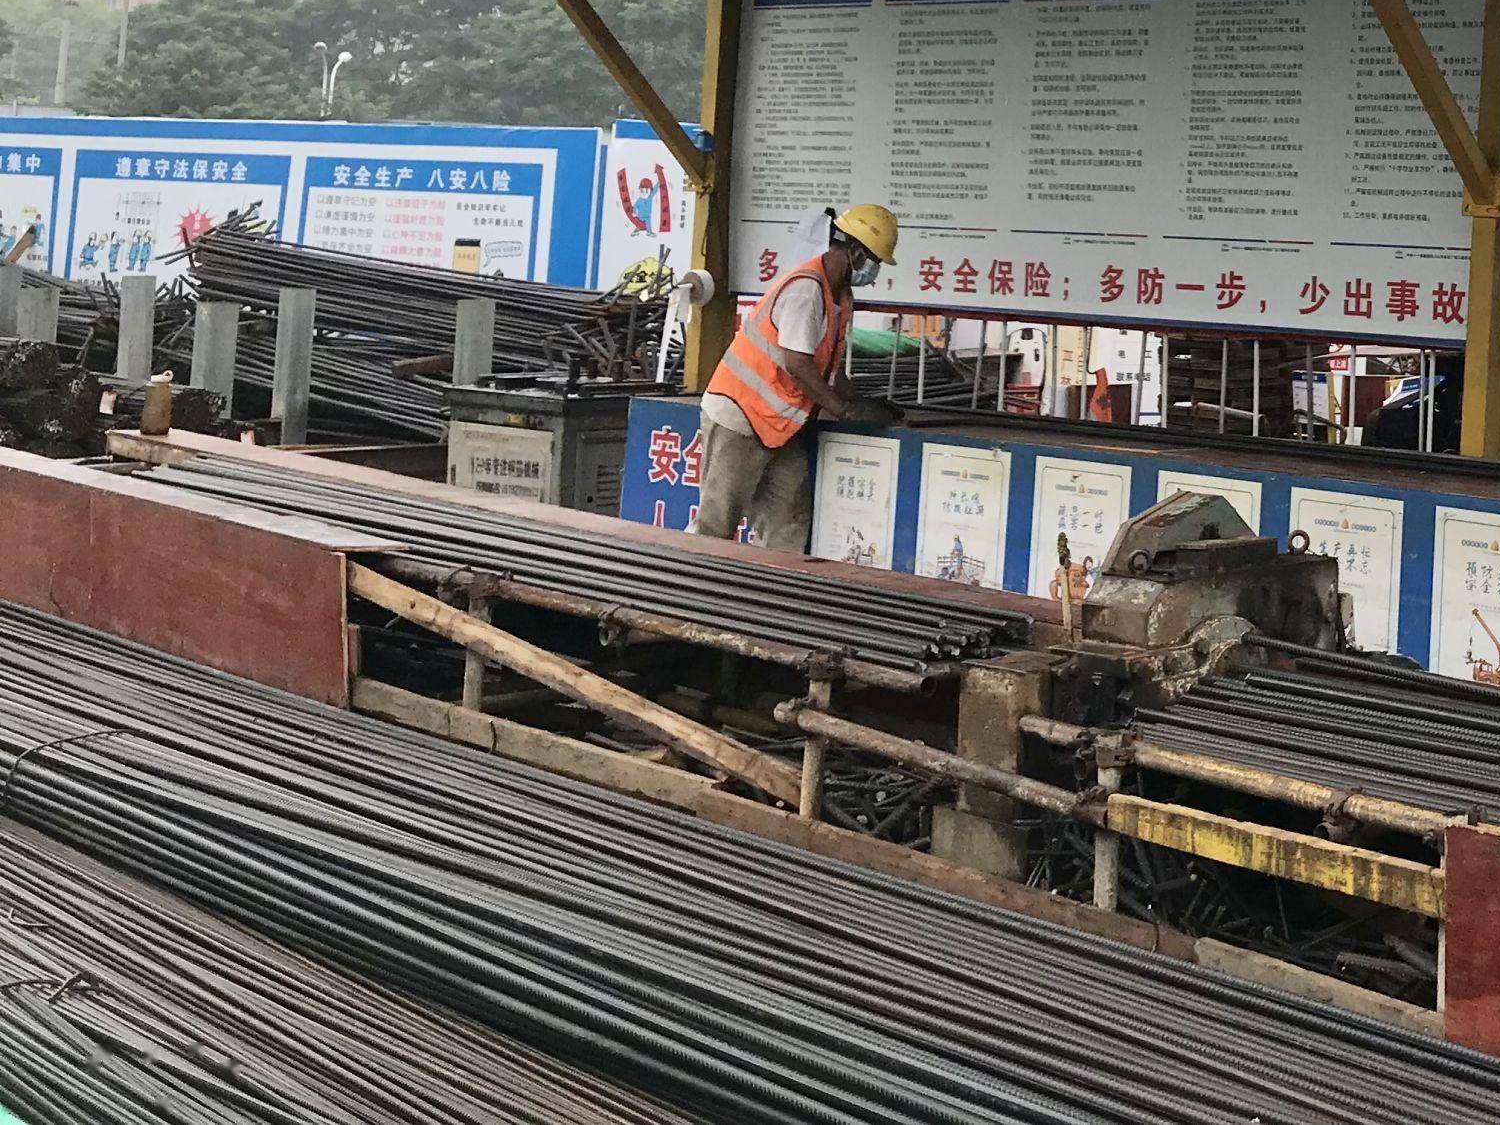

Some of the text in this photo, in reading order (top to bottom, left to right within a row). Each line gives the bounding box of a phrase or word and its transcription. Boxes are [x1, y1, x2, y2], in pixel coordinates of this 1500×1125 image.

[0, 152, 41, 174] 集中
[115, 157, 248, 182] 遵章守法保安全
[333, 165, 511, 193] 安全生产 八安八险
